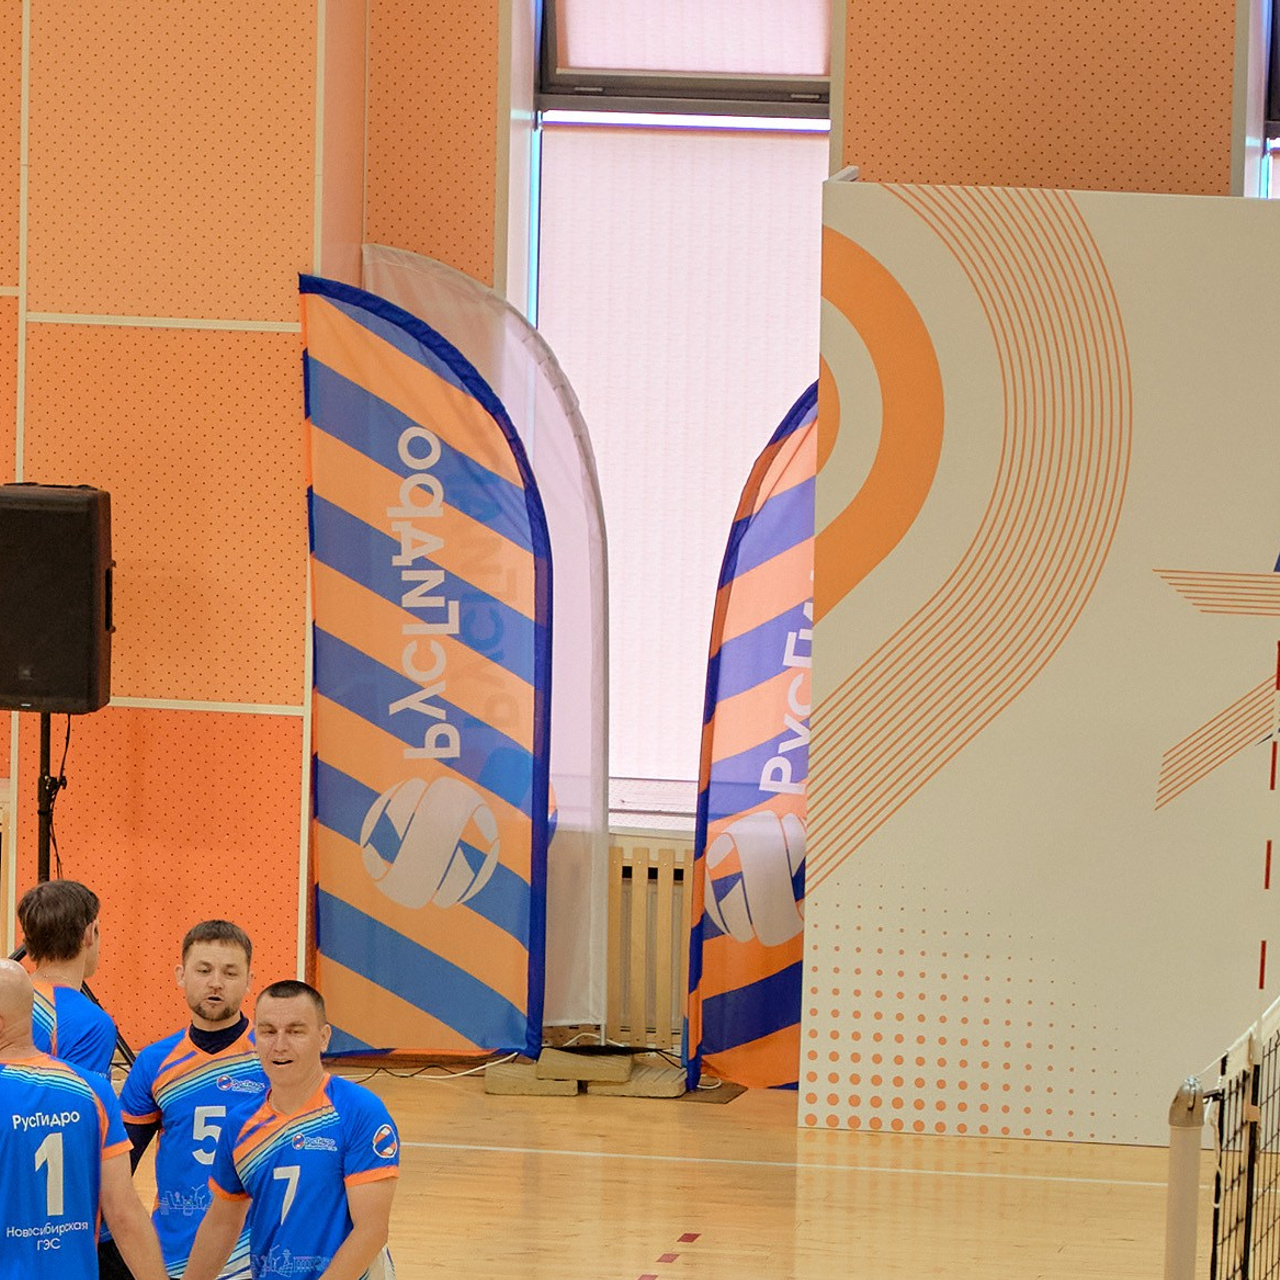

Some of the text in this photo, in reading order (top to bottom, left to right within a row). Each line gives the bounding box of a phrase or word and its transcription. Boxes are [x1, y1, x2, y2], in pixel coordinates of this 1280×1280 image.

[12, 1111, 80, 1132] РусГидро
[192, 1105, 227, 1165] 5
[34, 1132, 64, 1216] 1
[273, 1165, 301, 1226] 7
[6, 1222, 89, 1238] Новосибирская
[36, 1237, 61, 1251] ГЭС
